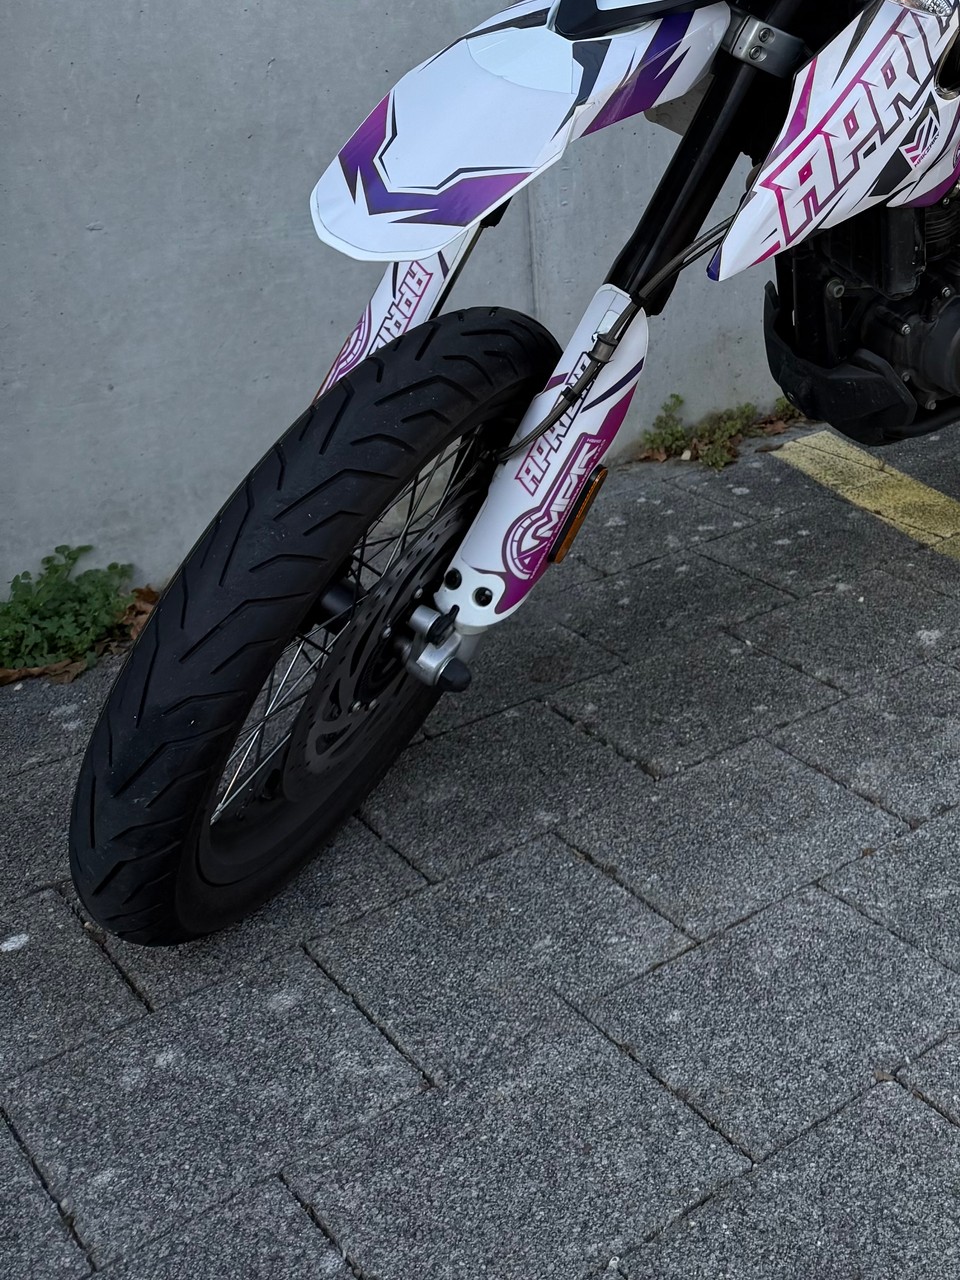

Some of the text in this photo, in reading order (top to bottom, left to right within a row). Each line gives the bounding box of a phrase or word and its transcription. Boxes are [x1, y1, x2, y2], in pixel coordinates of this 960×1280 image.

[366, 261, 434, 357] APRI
[514, 351, 597, 497] APRIL
[536, 442, 599, 538] MPR
